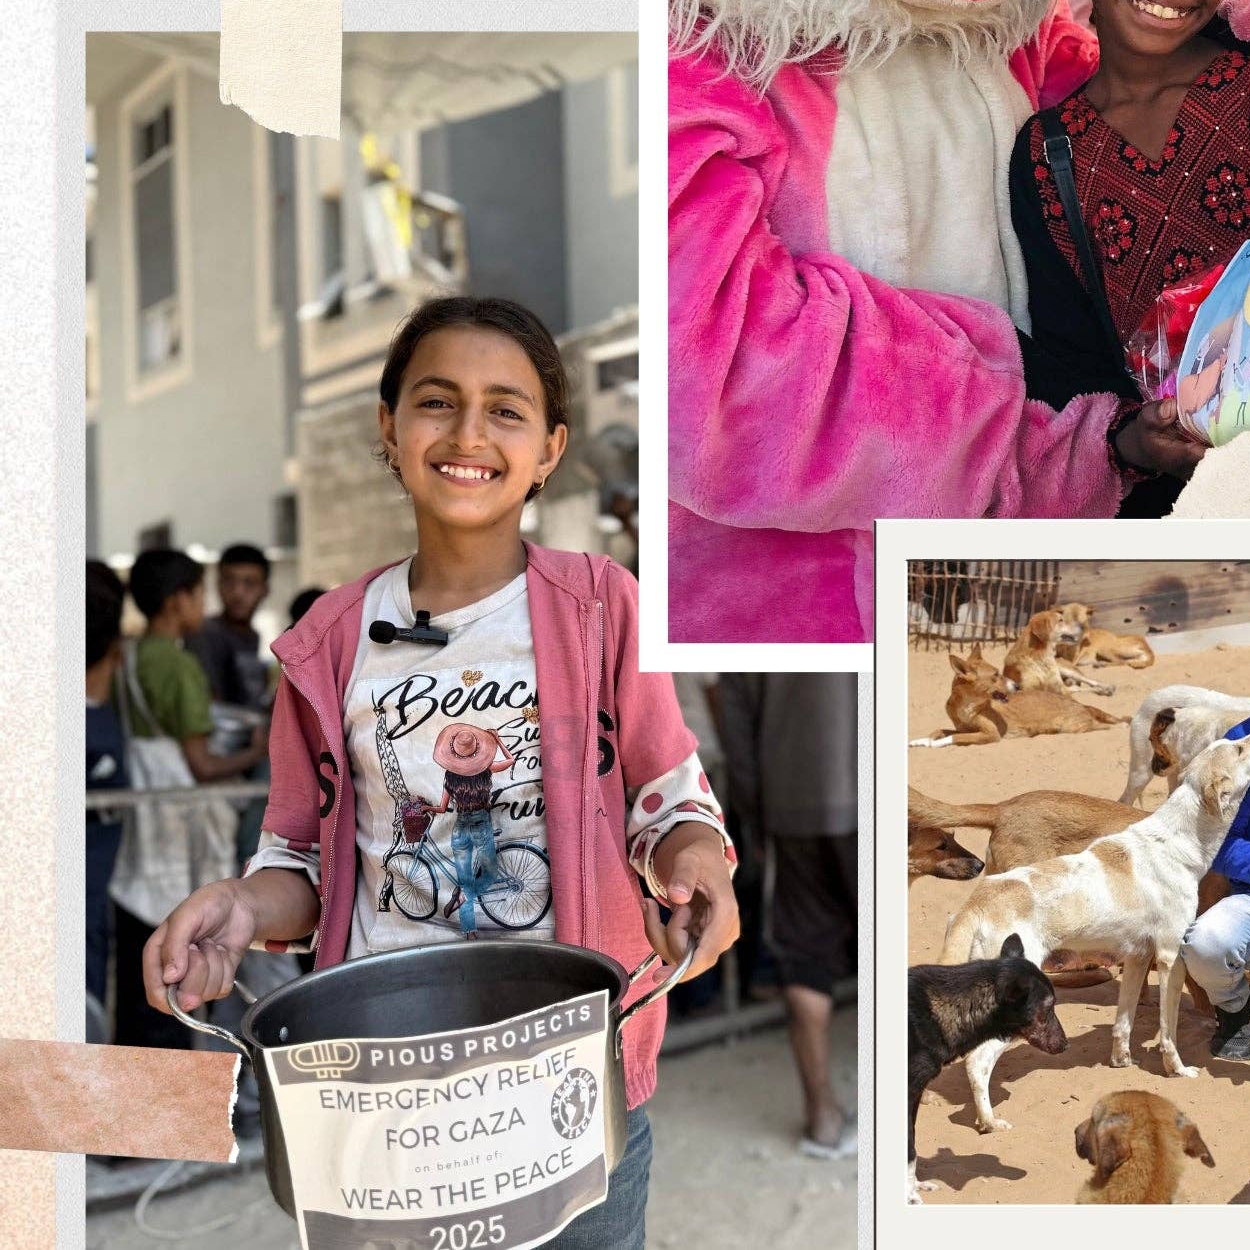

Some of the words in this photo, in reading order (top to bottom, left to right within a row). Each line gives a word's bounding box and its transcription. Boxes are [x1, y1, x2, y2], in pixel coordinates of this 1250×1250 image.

[377, 674, 539, 740] Beac
[371, 1041, 455, 1067] PIOUS
[464, 1004, 592, 1058] PROJECTS
[319, 1072, 489, 1114] EMERGENCY
[497, 1047, 578, 1091] RELIEF
[386, 1128, 440, 1151] FOR
[448, 1106, 527, 1144] GAZA
[341, 1187, 423, 1211] WEAR
[430, 1178, 486, 1207] THE
[495, 1146, 574, 1196] PEACE
[414, 1164, 431, 1174] on
[437, 1154, 481, 1172] behalf
[429, 1214, 506, 1250] 2025
